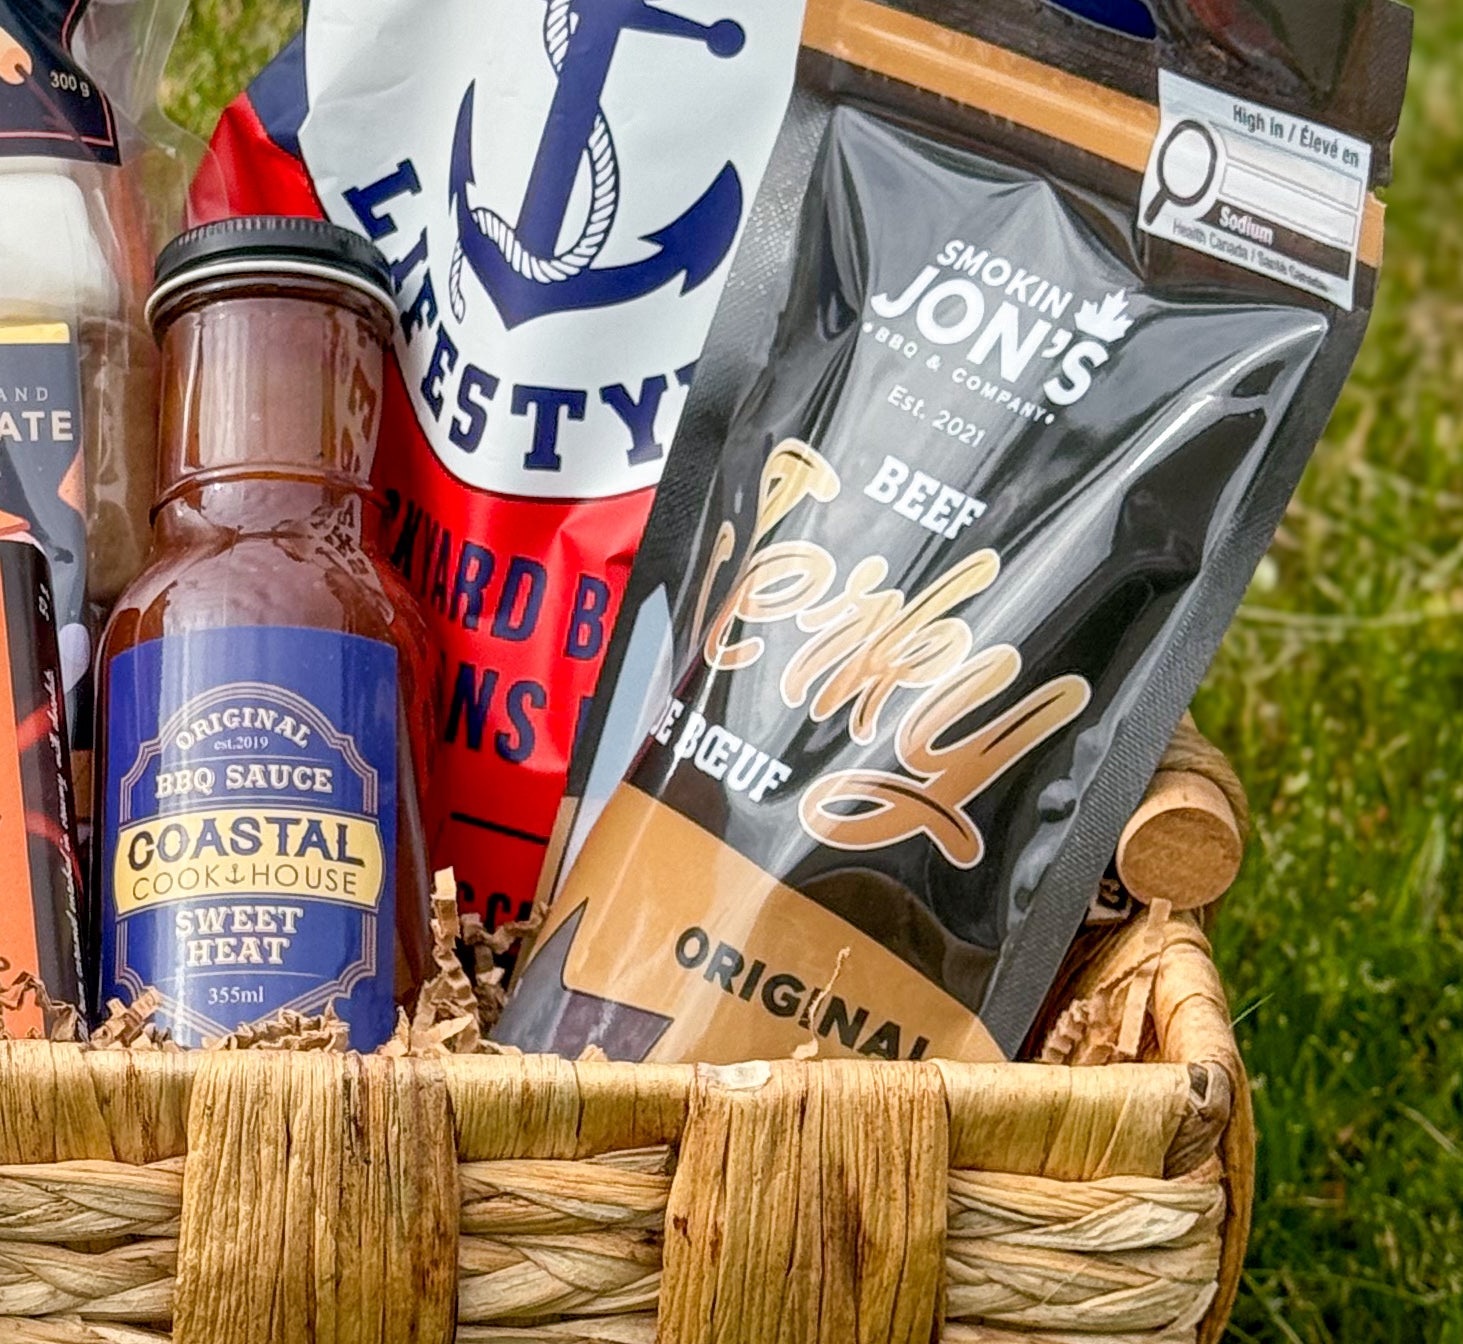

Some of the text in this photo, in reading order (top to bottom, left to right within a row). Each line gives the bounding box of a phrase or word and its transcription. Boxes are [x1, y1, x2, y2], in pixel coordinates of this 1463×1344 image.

[50, 70, 78, 92] 300
[1233, 105, 1265, 134] High
[1270, 117, 1284, 139] in
[1299, 124, 1339, 158] Élevé
[1342, 147, 1359, 168] en
[1172, 219, 1207, 244] Health
[1209, 230, 1249, 260] Canada
[1219, 206, 1274, 246] Sodium
[937, 239, 1073, 319] SMOKIN
[871, 265, 1109, 405] JON'S
[926, 355, 941, 372] &
[951, 367, 1047, 424] COMPANY
[887, 385, 985, 447] Est. 2021
[864, 455, 987, 540] BEEF
[686, 438, 1092, 870] Jerky
[175, 707, 311, 751] ORIGINAL
[155, 764, 333, 799] BBQ SAUCE
[128, 816, 365, 872] COASTAL
[133, 863, 357, 901] COOK HOUSE
[174, 906, 304, 937] SWEET
[186, 936, 290, 967] HEAT
[207, 986, 264, 1004] 355ml
